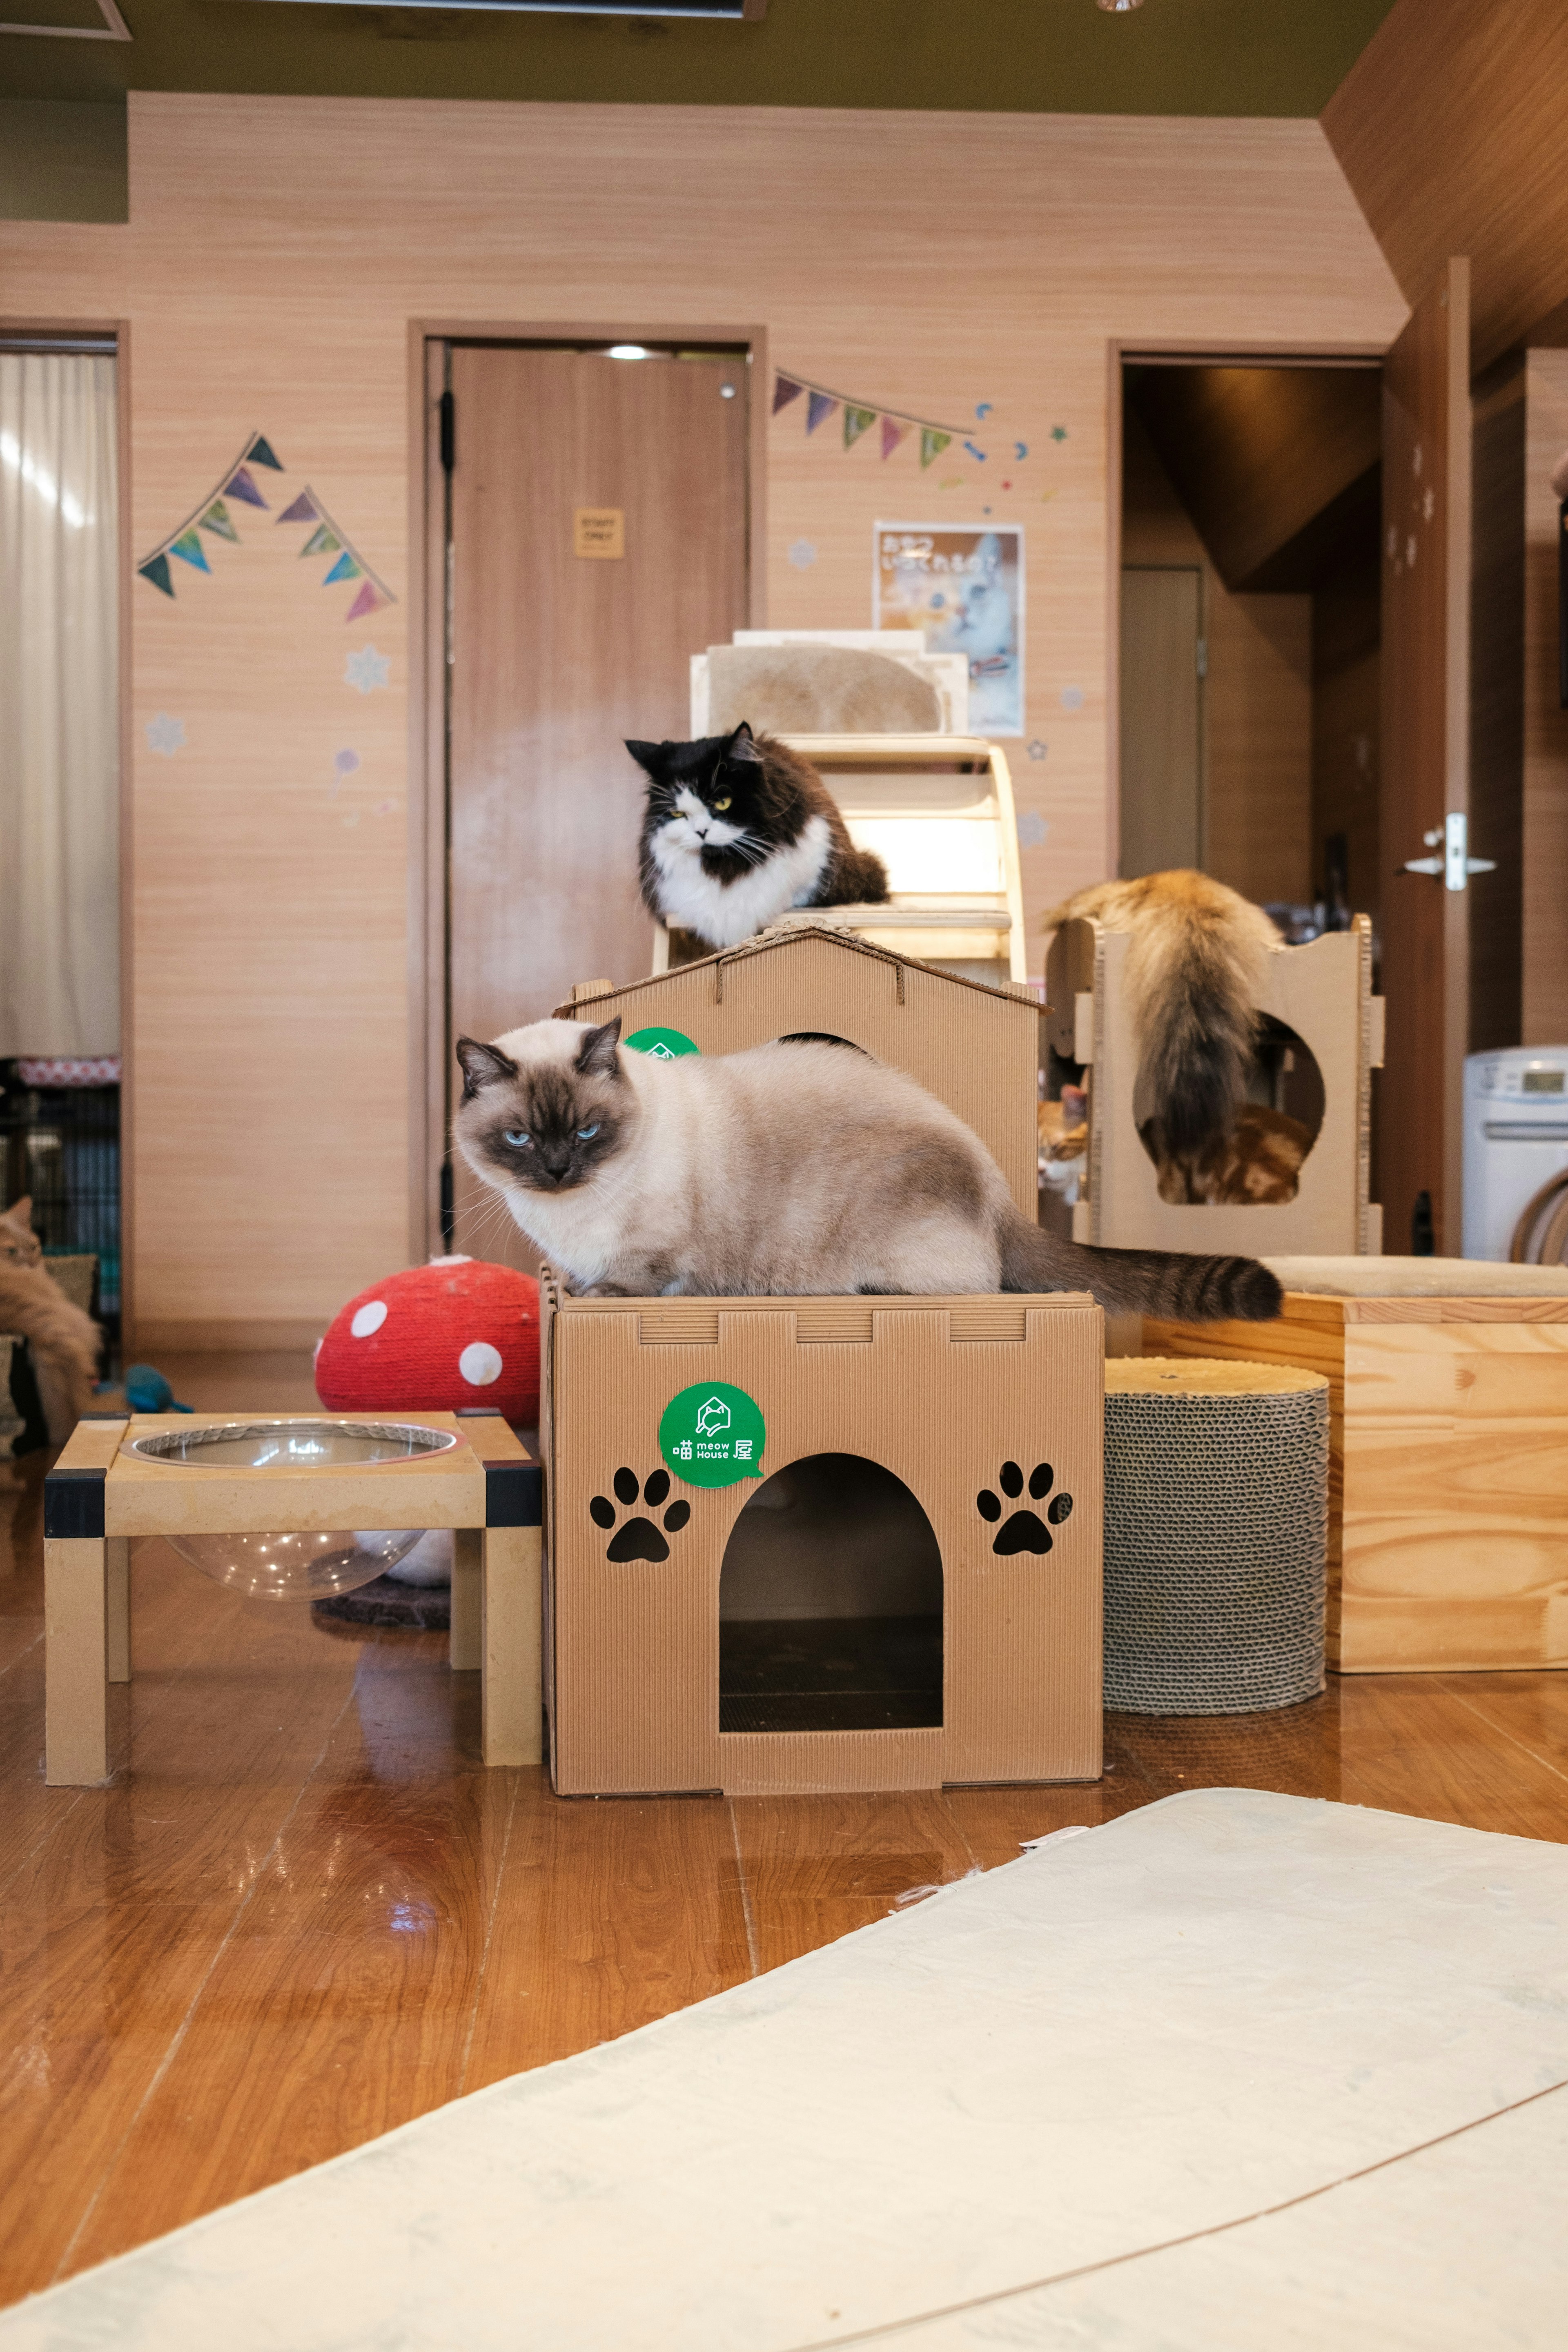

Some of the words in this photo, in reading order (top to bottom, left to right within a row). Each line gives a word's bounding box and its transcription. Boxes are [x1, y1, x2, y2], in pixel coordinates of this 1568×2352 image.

[673, 1440, 693, 1460] 喵
[733, 1440, 752, 1460] 屋
[697, 1450, 729, 1459] House
